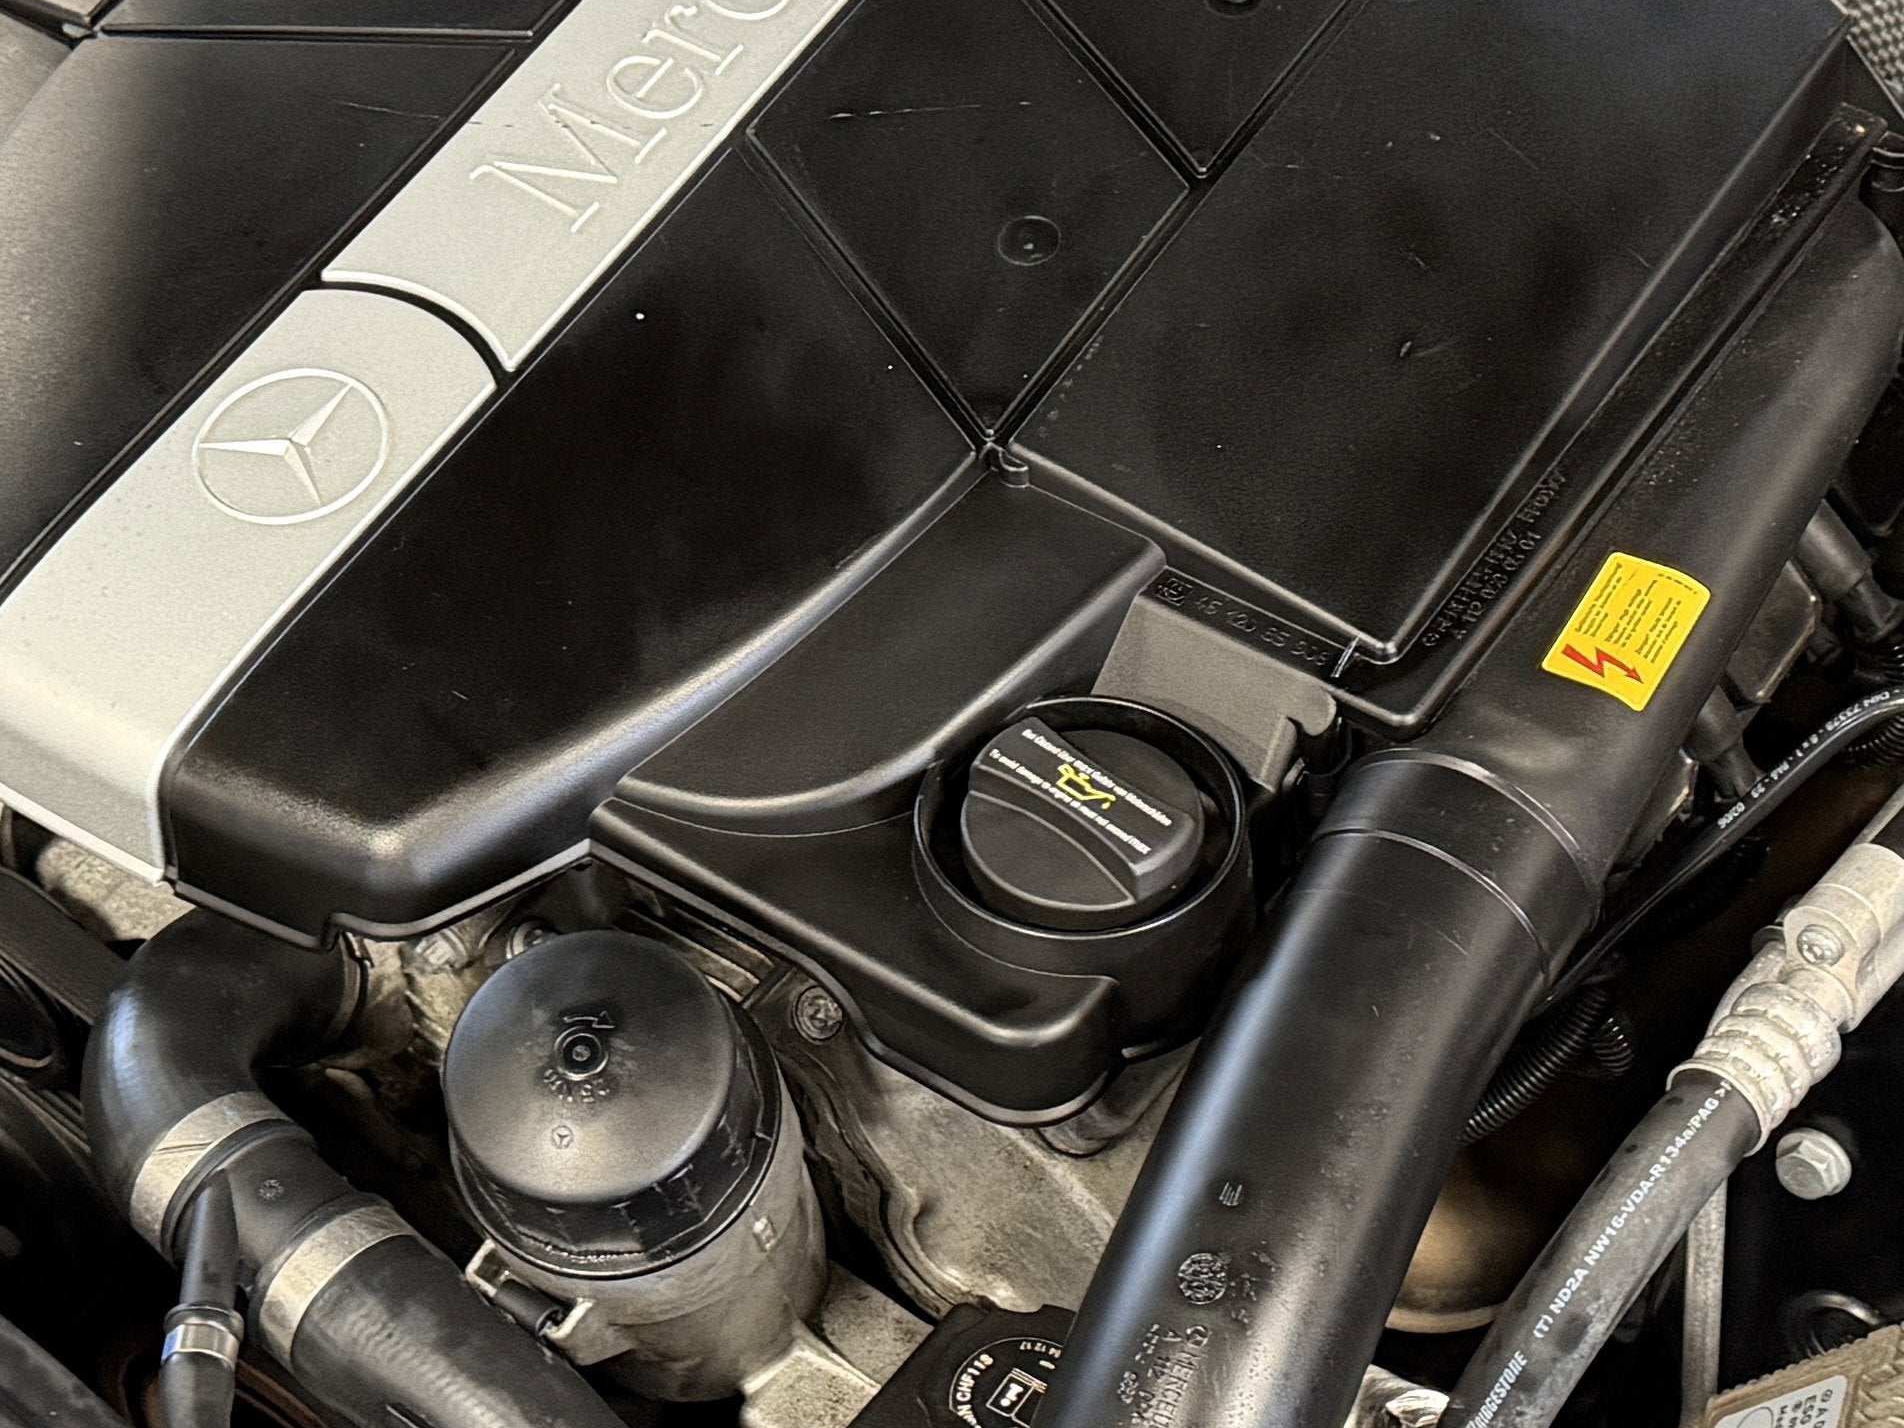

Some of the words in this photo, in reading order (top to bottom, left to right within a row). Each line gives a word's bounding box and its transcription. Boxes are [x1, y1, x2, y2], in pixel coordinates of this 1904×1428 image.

[1532, 1308, 1553, 1340] (T)
[1546, 1260, 1591, 1316] ND2A
[1815, 1405, 1829, 1420] A
